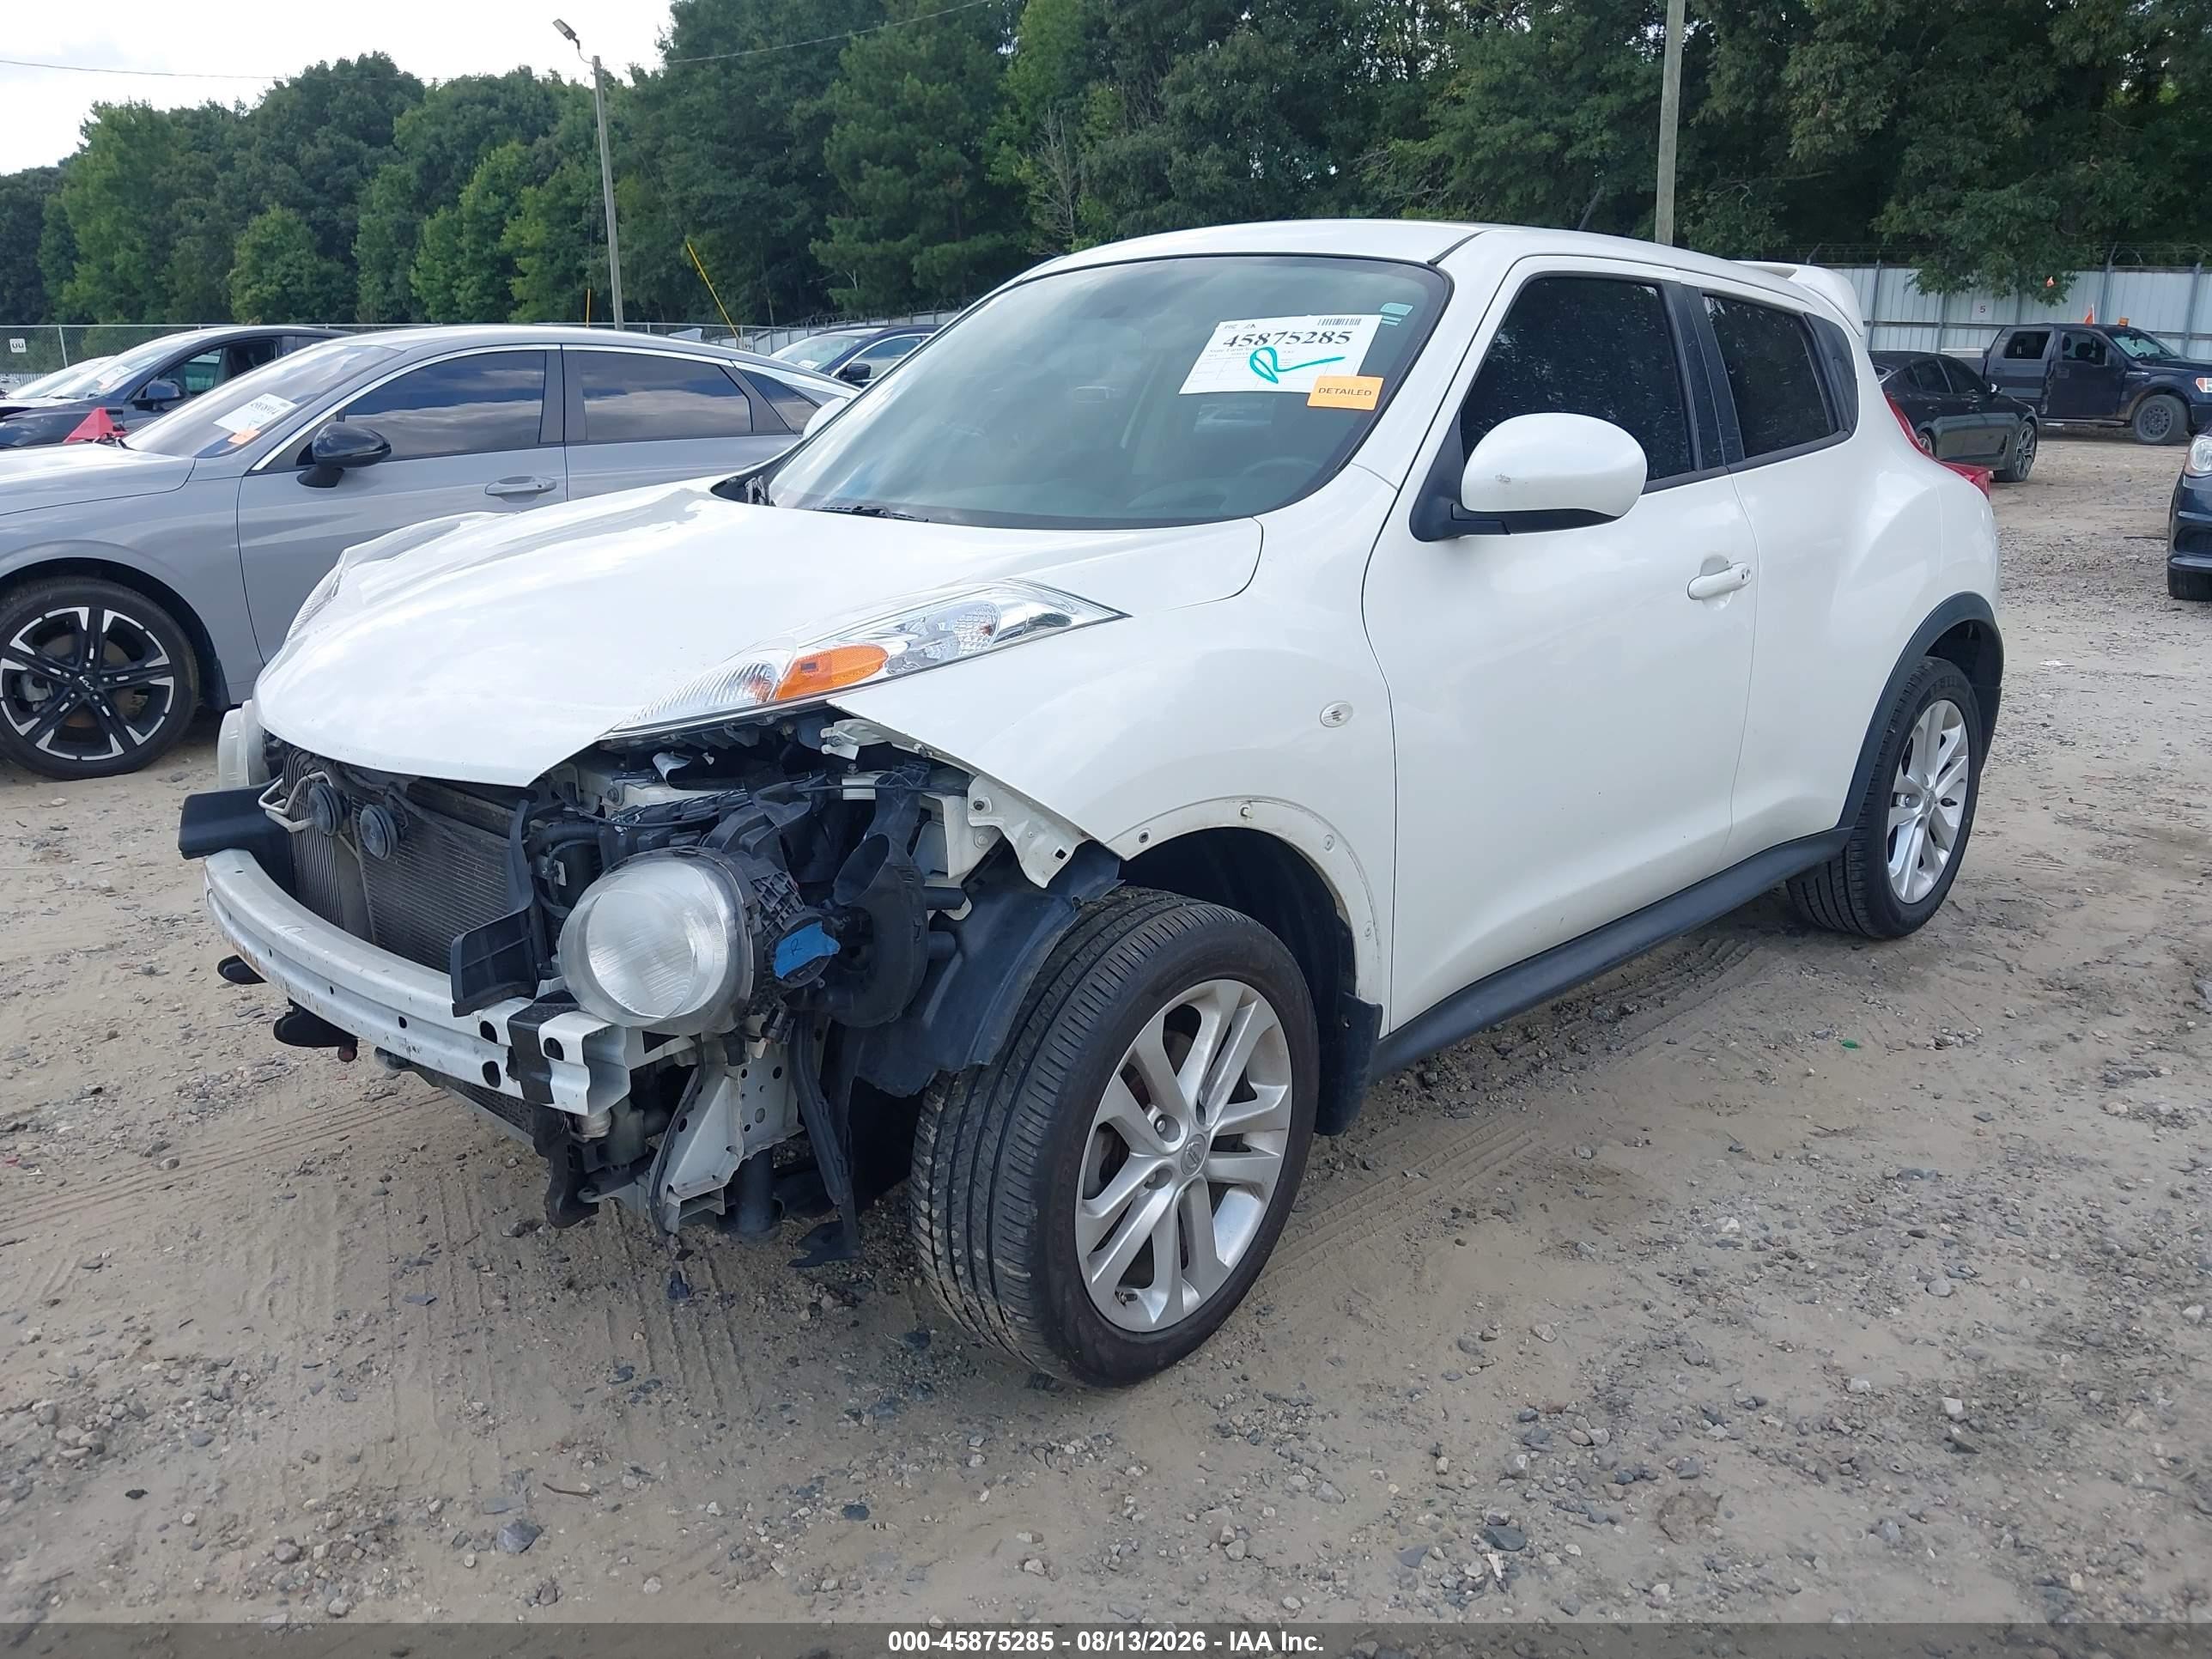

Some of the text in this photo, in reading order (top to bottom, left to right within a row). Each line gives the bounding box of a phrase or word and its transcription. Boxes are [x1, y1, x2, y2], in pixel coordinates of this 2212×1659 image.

[1979, 305, 1986, 313] 5
[1223, 331, 1353, 348] 45875285
[1318, 387, 1372, 397] DETAILED
